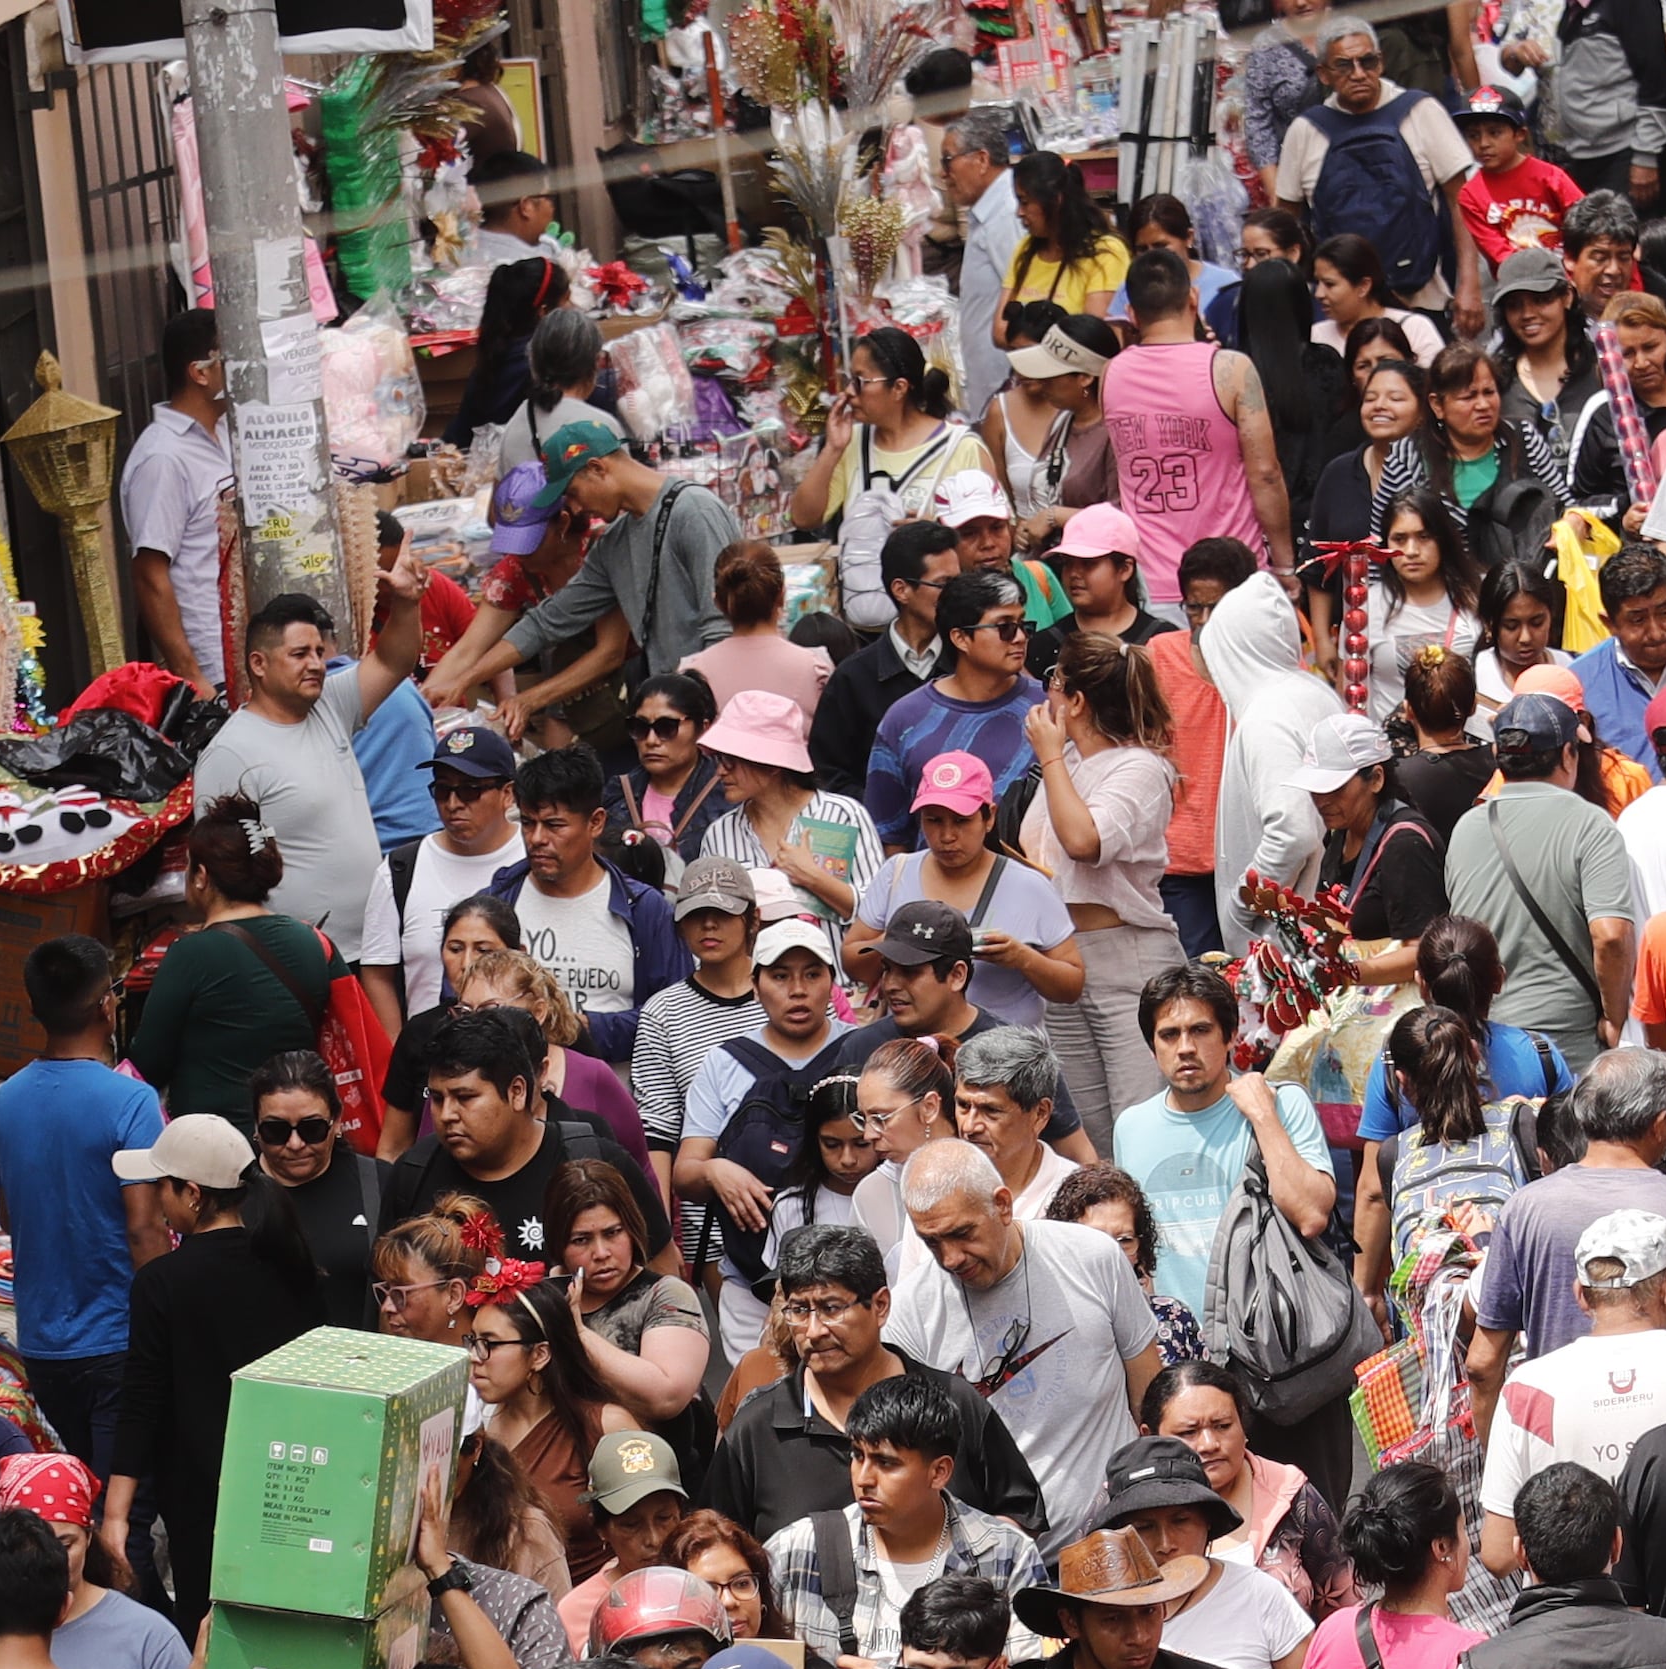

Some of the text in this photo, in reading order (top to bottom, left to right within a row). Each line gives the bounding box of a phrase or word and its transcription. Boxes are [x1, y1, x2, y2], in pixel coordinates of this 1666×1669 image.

[246, 410, 310, 426] ALQUILO
[1110, 413, 1213, 455] NEW YORK
[1130, 453, 1200, 514] 23
[568, 967, 621, 990] PUEDO
[1592, 1393, 1652, 1409] SIDERPERU
[1592, 1444, 1620, 1464] YO
[302, 1466, 316, 1475] 721
[262, 1511, 313, 1524] MADE IN CHINA
